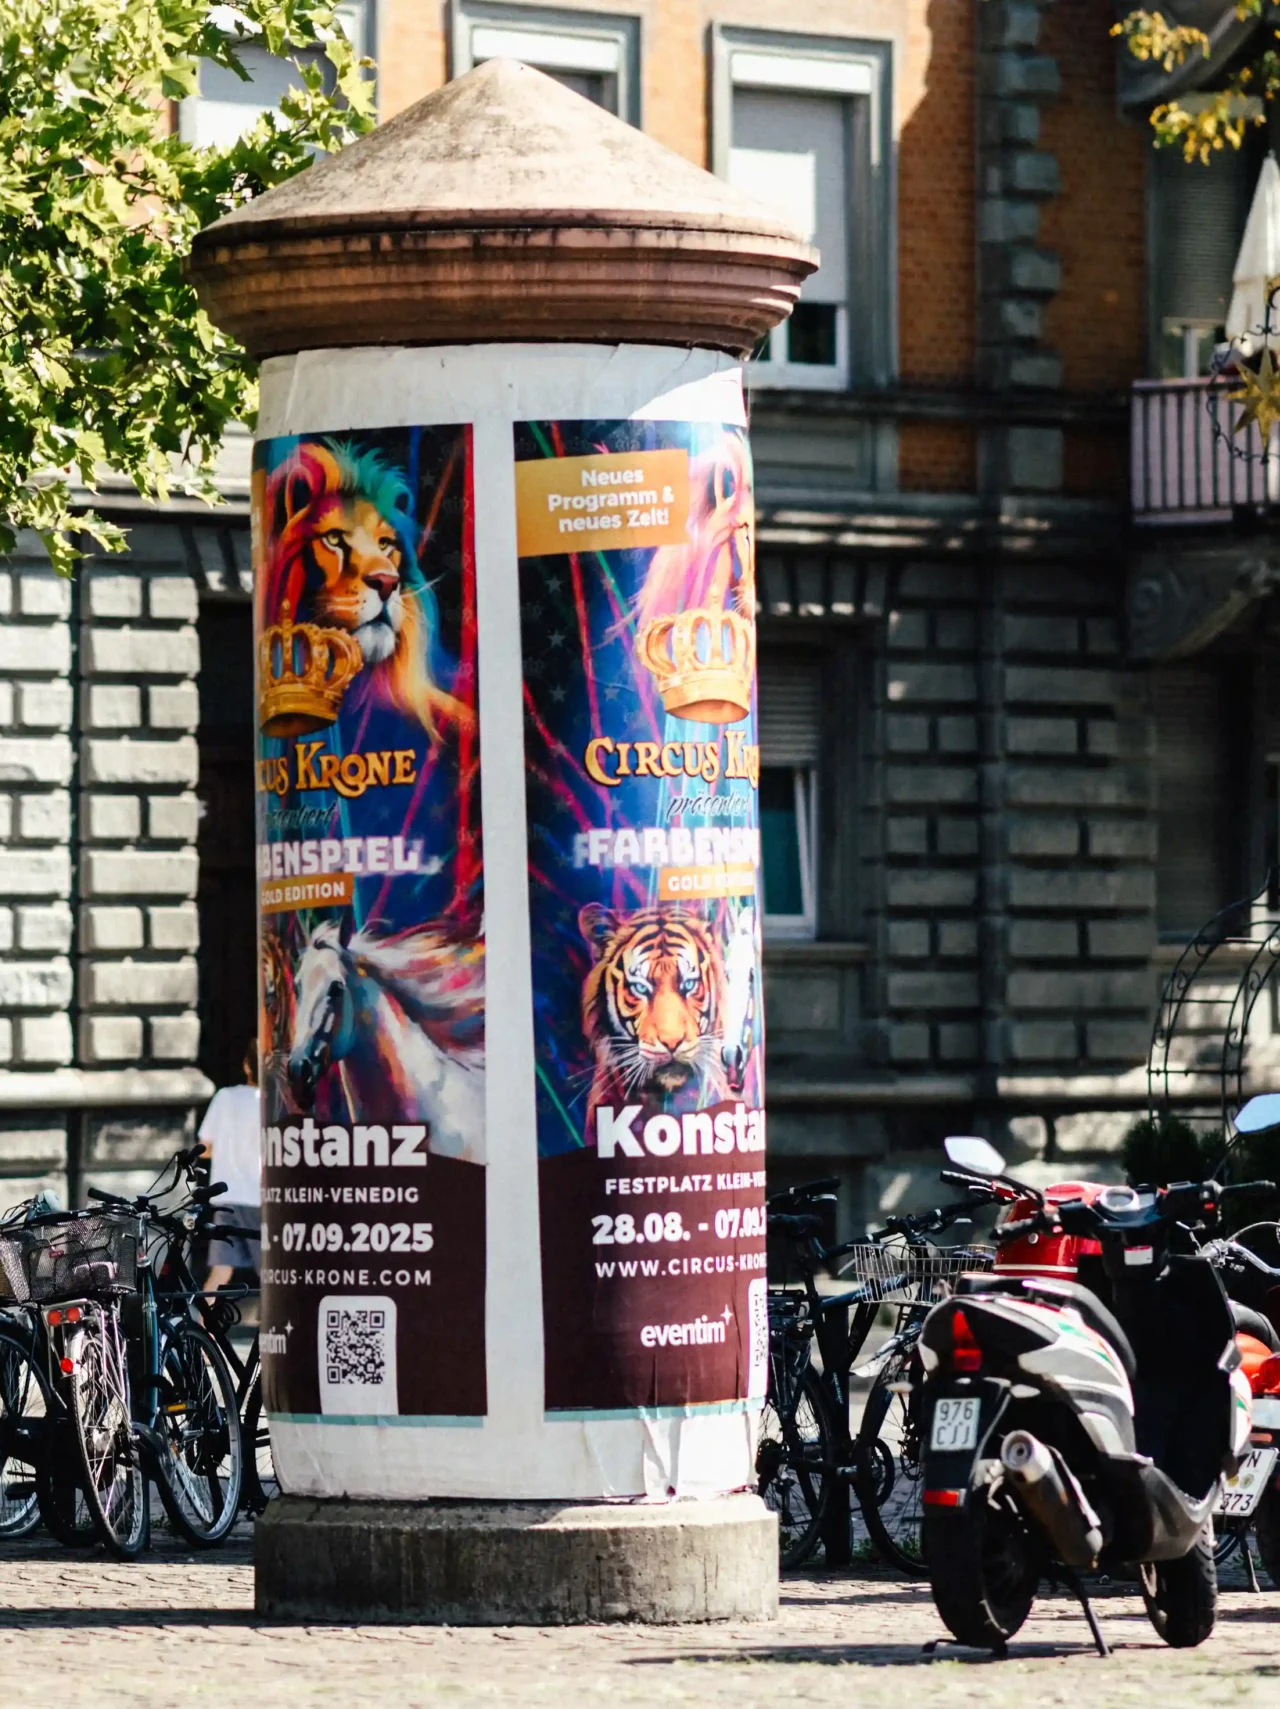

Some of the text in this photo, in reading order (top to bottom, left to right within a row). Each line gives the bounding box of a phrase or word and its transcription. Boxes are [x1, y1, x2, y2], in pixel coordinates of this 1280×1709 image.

[581, 467, 644, 487] Neues
[548, 485, 675, 512] Programm &
[559, 507, 670, 533] neues Zeit!
[294, 741, 417, 798] KRONE
[584, 736, 720, 787] CIRCUS
[285, 881, 345, 903] EDITION
[667, 873, 711, 892] GOLD
[284, 1186, 420, 1204] KLEIN-VENEDIG
[606, 1174, 713, 1195] FESTPLATZ
[282, 1222, 435, 1252] 07.09.2025
[591, 1211, 692, 1245] 28.08.
[698, 1222, 709, 1232] -
[640, 1315, 726, 1348] eventim
[940, 1401, 974, 1421] 976
[936, 1426, 970, 1445] CJJ
